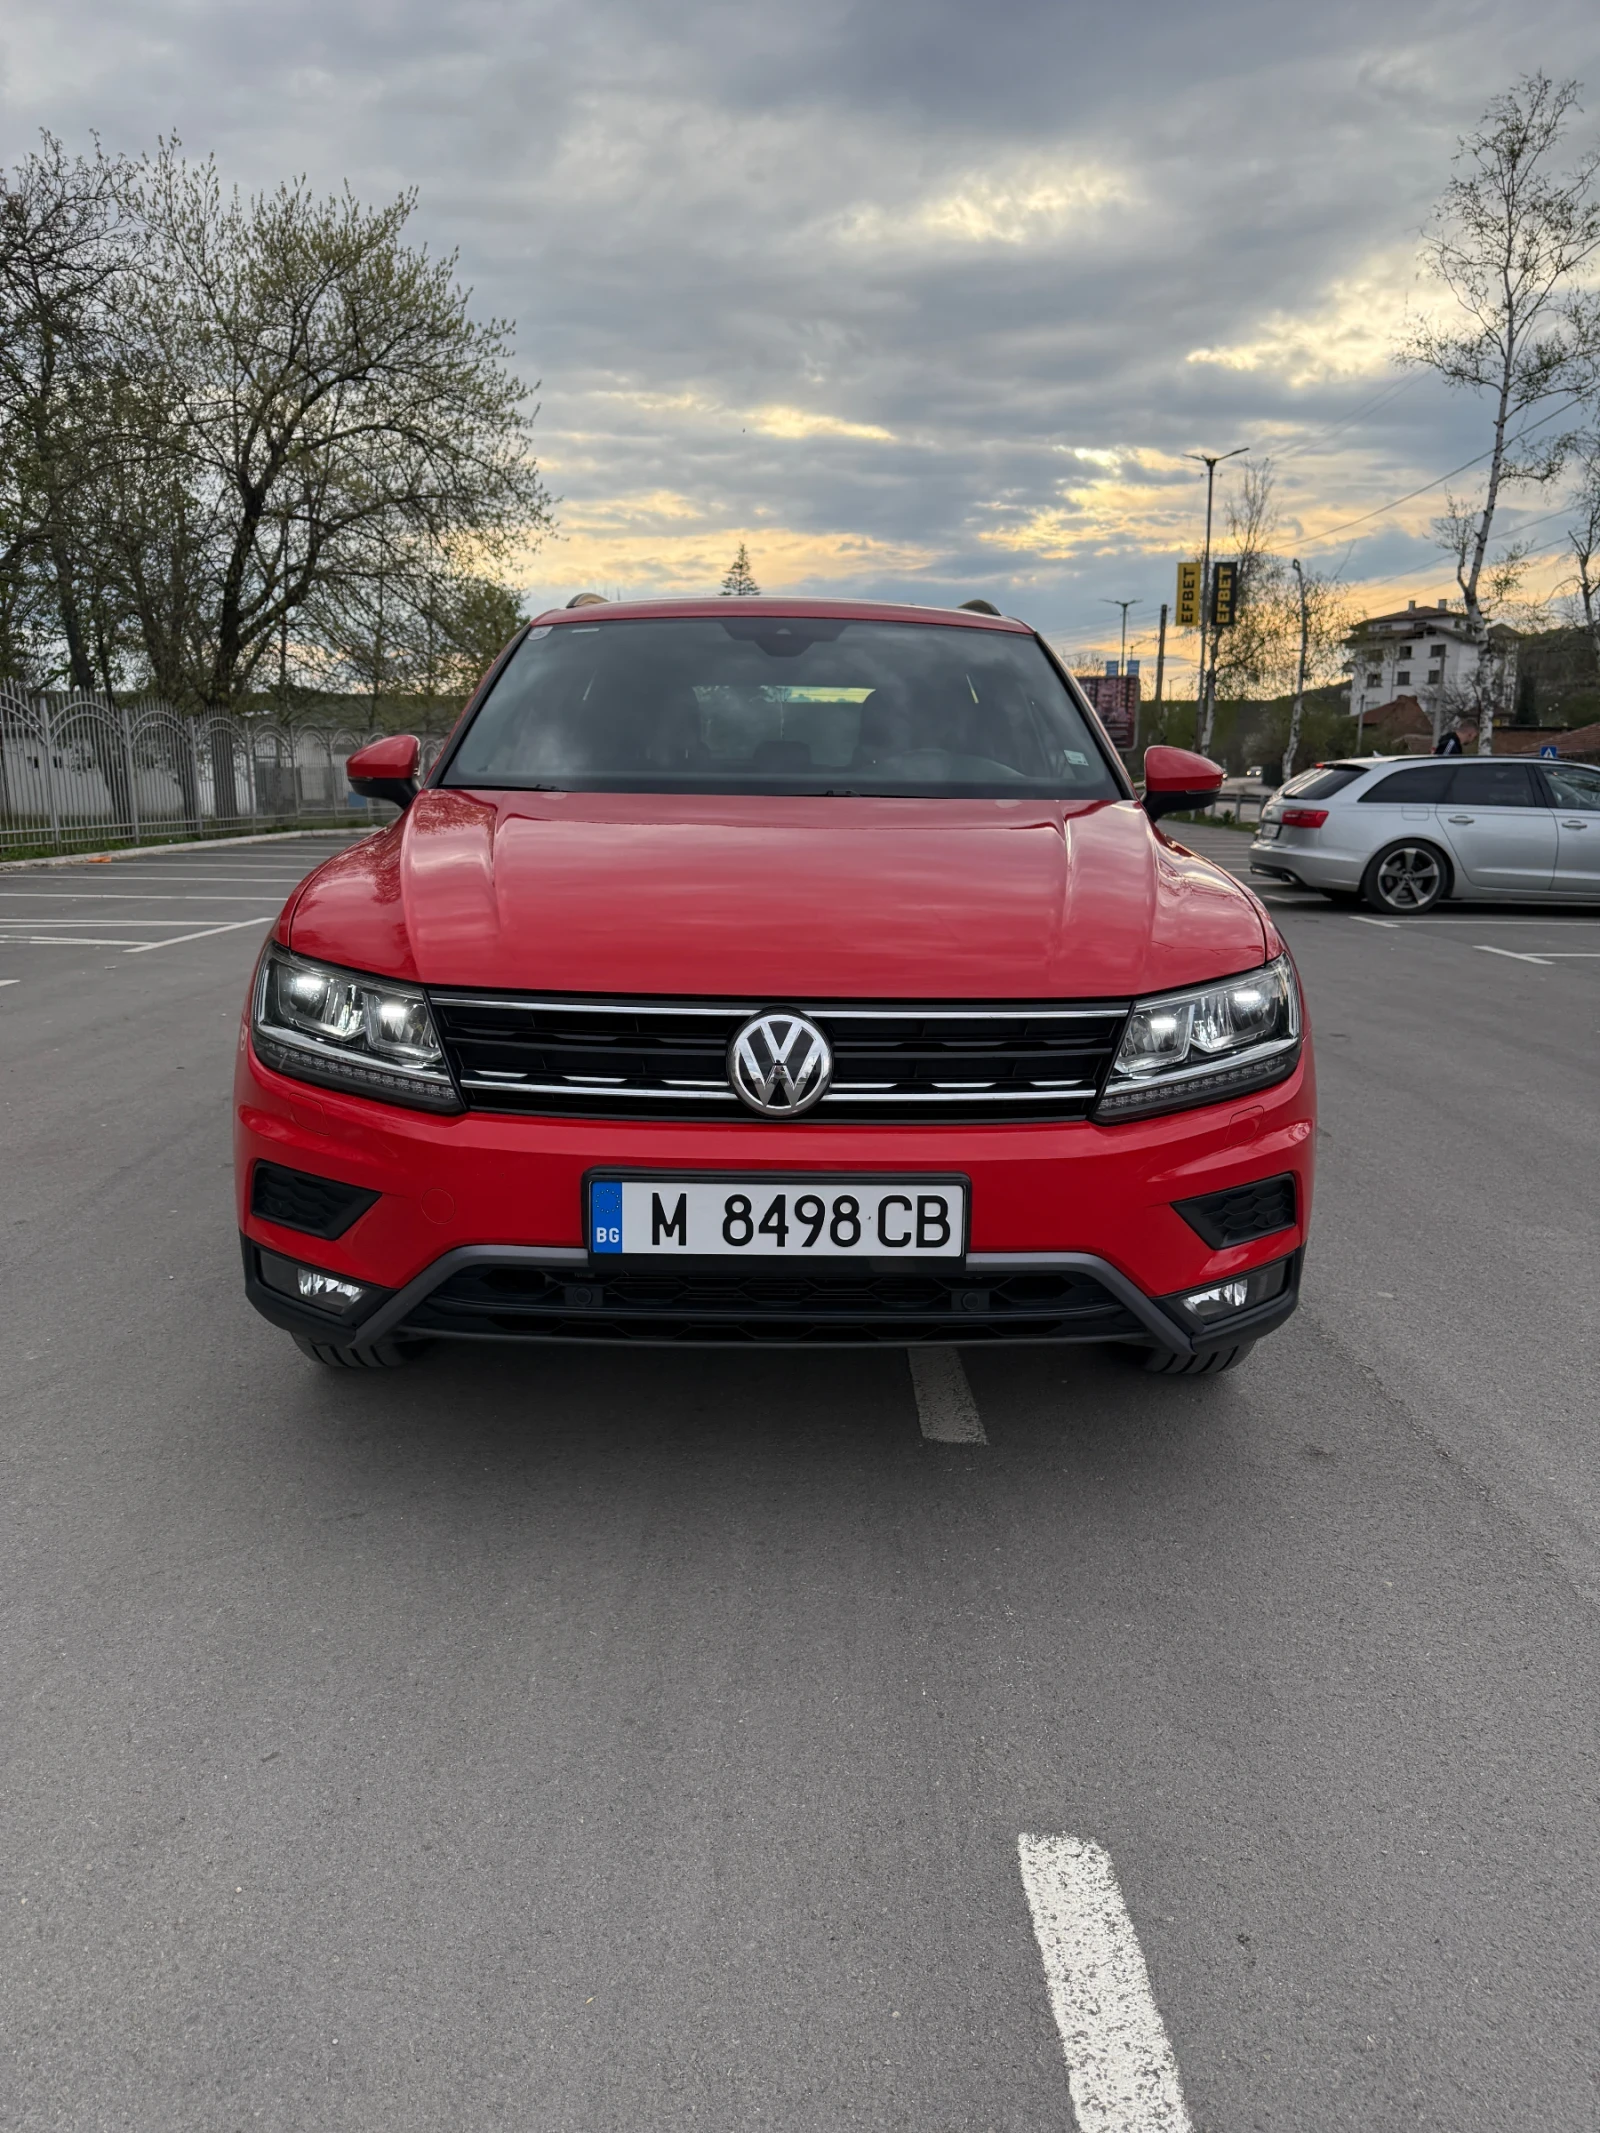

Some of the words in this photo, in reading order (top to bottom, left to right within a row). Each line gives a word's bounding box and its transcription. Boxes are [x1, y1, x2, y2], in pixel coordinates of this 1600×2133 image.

[1181, 567, 1195, 623] EFBET
[1216, 566, 1232, 623] EFBET
[596, 1227, 620, 1243] BG
[651, 1192, 687, 1246] M
[722, 1194, 861, 1248] 8498
[877, 1194, 951, 1248] CB
